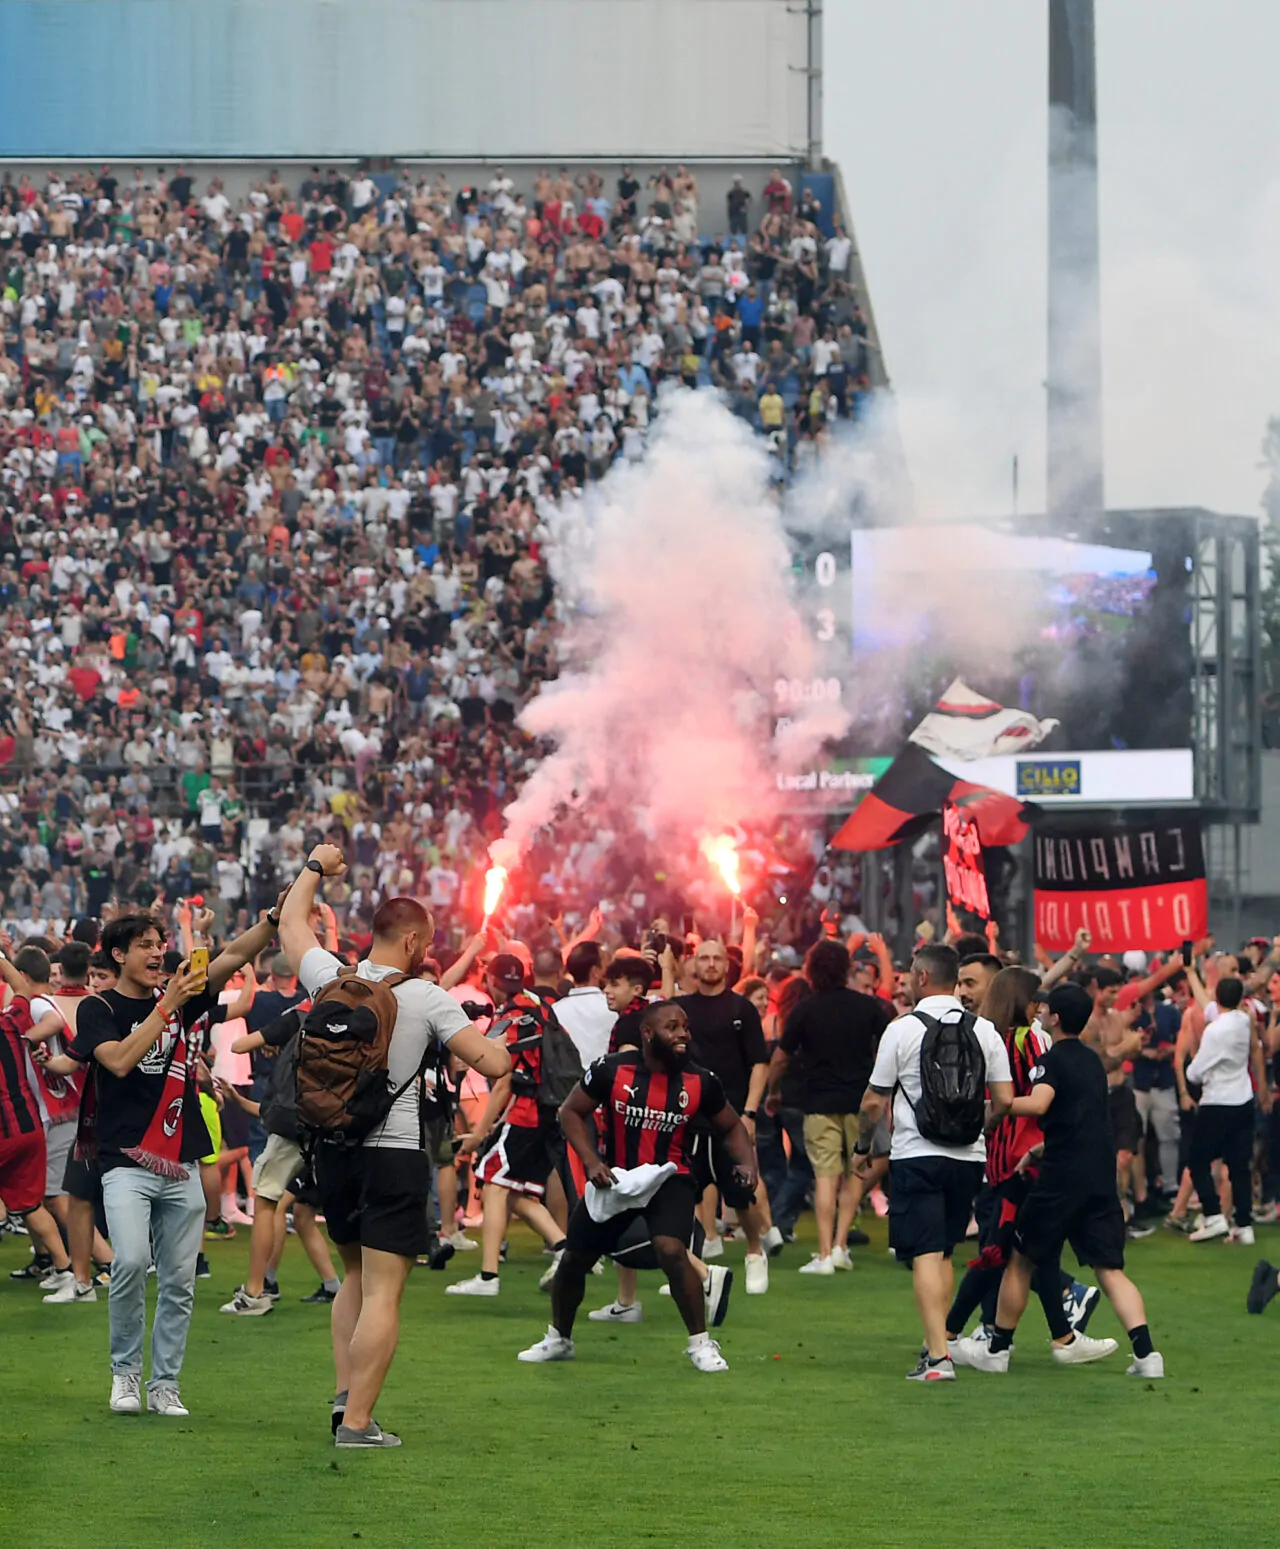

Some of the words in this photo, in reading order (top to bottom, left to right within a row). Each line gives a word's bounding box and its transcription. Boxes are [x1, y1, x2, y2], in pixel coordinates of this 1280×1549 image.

[815, 551, 836, 587] 0
[816, 608, 836, 641] 3
[615, 1099, 690, 1125] Emirates
